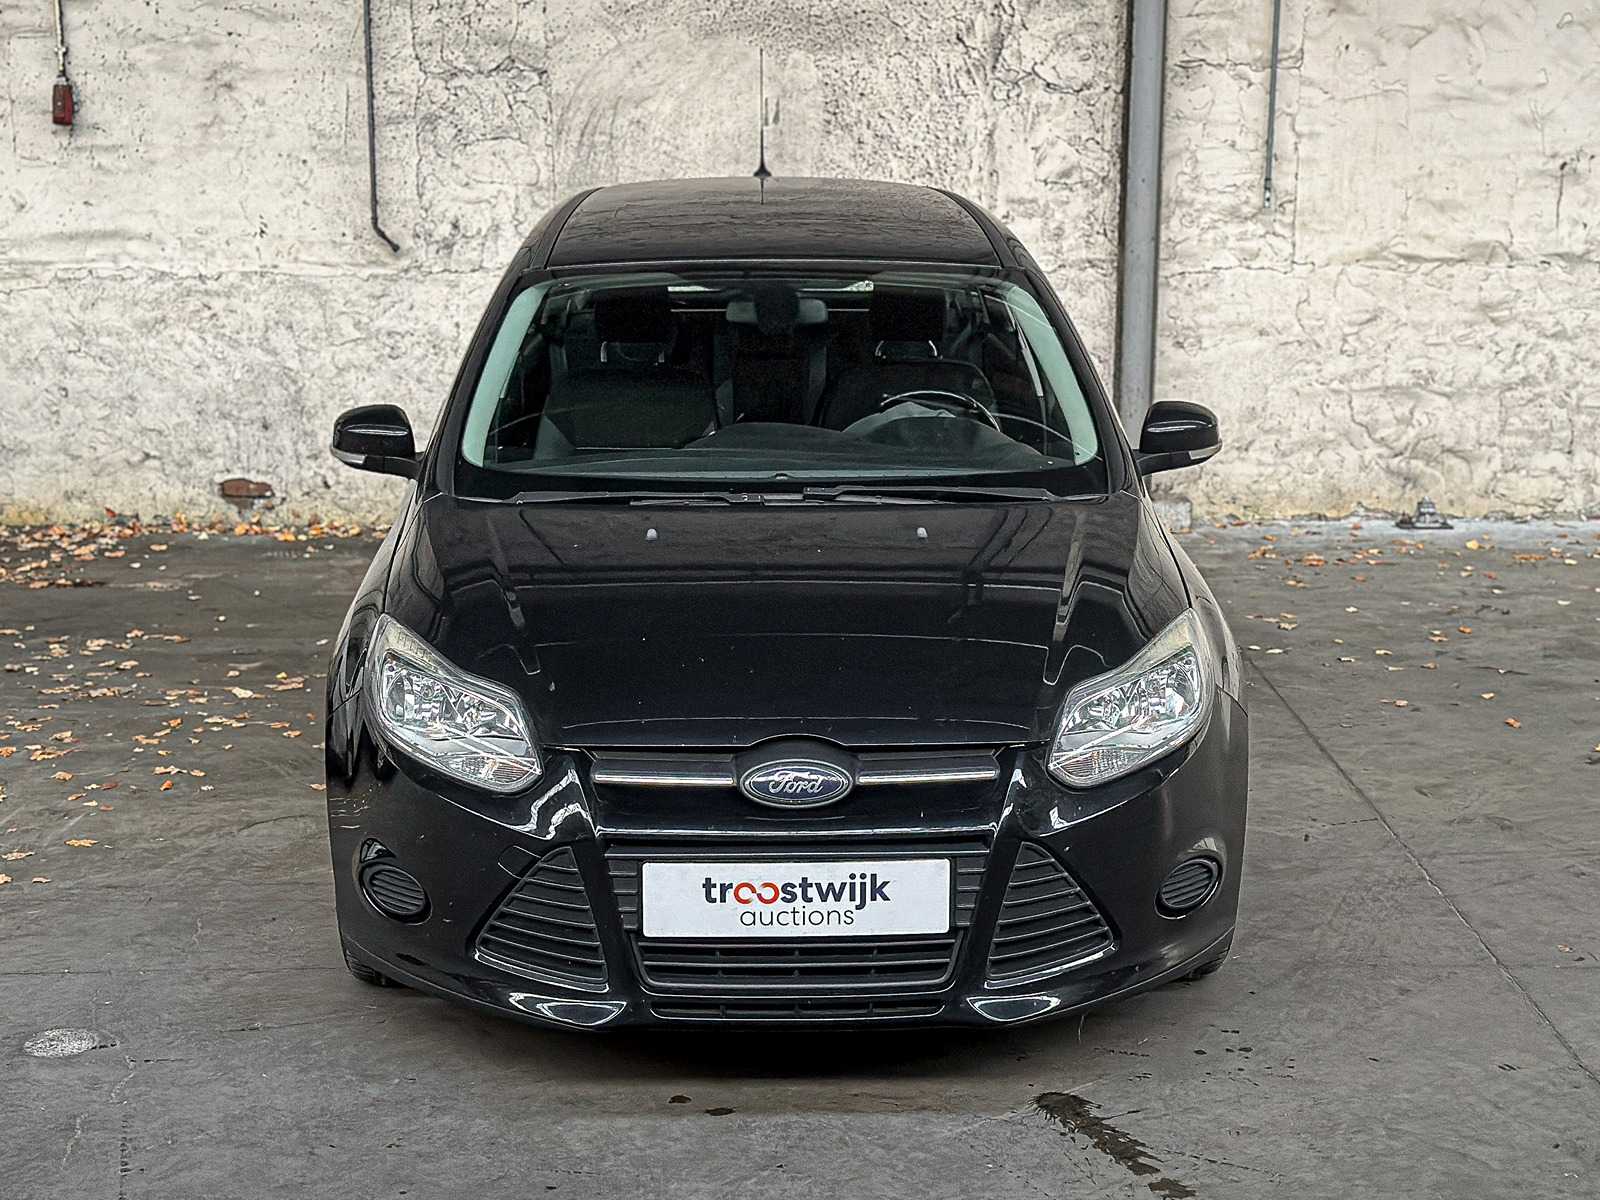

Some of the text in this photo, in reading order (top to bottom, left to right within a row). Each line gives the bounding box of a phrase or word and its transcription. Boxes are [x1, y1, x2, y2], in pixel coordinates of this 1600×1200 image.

[768, 770, 823, 794] Ford
[702, 873, 891, 910] troostwijk
[739, 906, 855, 927] auctions
